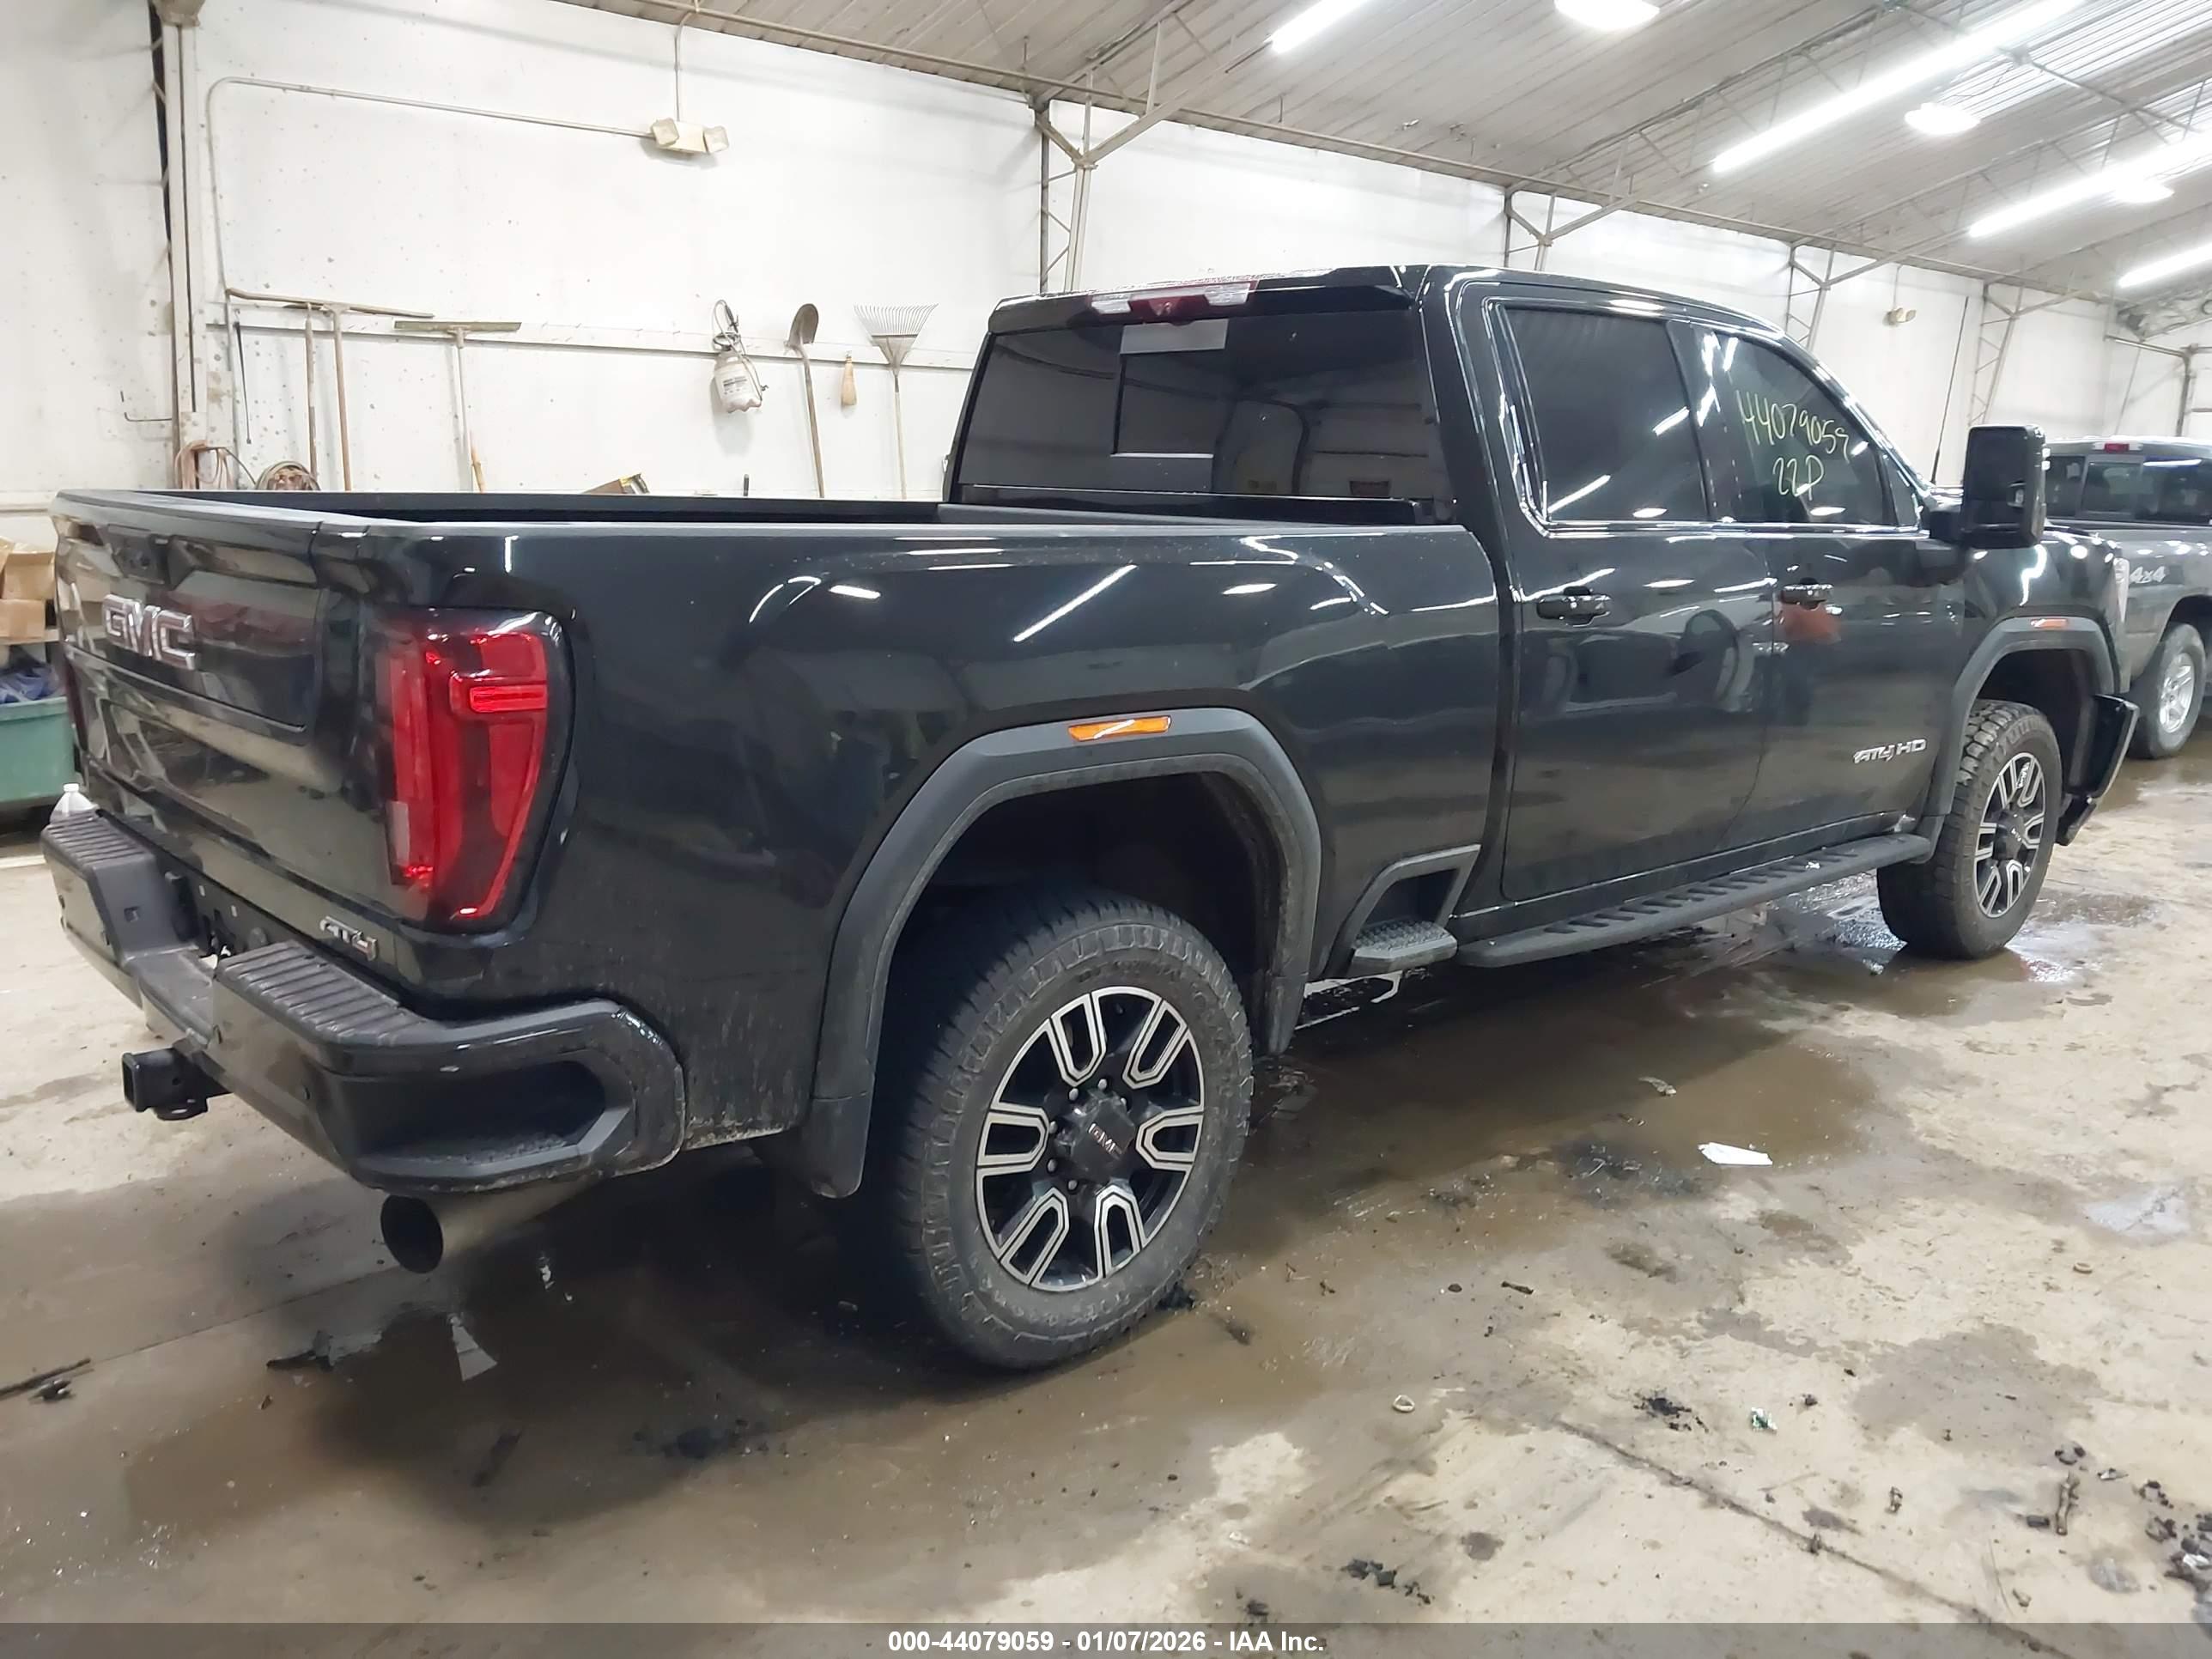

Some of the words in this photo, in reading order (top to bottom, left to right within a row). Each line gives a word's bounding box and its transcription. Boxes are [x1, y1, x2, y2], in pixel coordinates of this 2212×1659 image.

[1735, 389, 1851, 465] 44079059
[101, 593, 196, 671] GMC
[1853, 744, 1895, 764] AT4
[1896, 738, 1927, 756] HD
[319, 915, 378, 962] AT4
[1088, 1122, 1123, 1160] GMC
